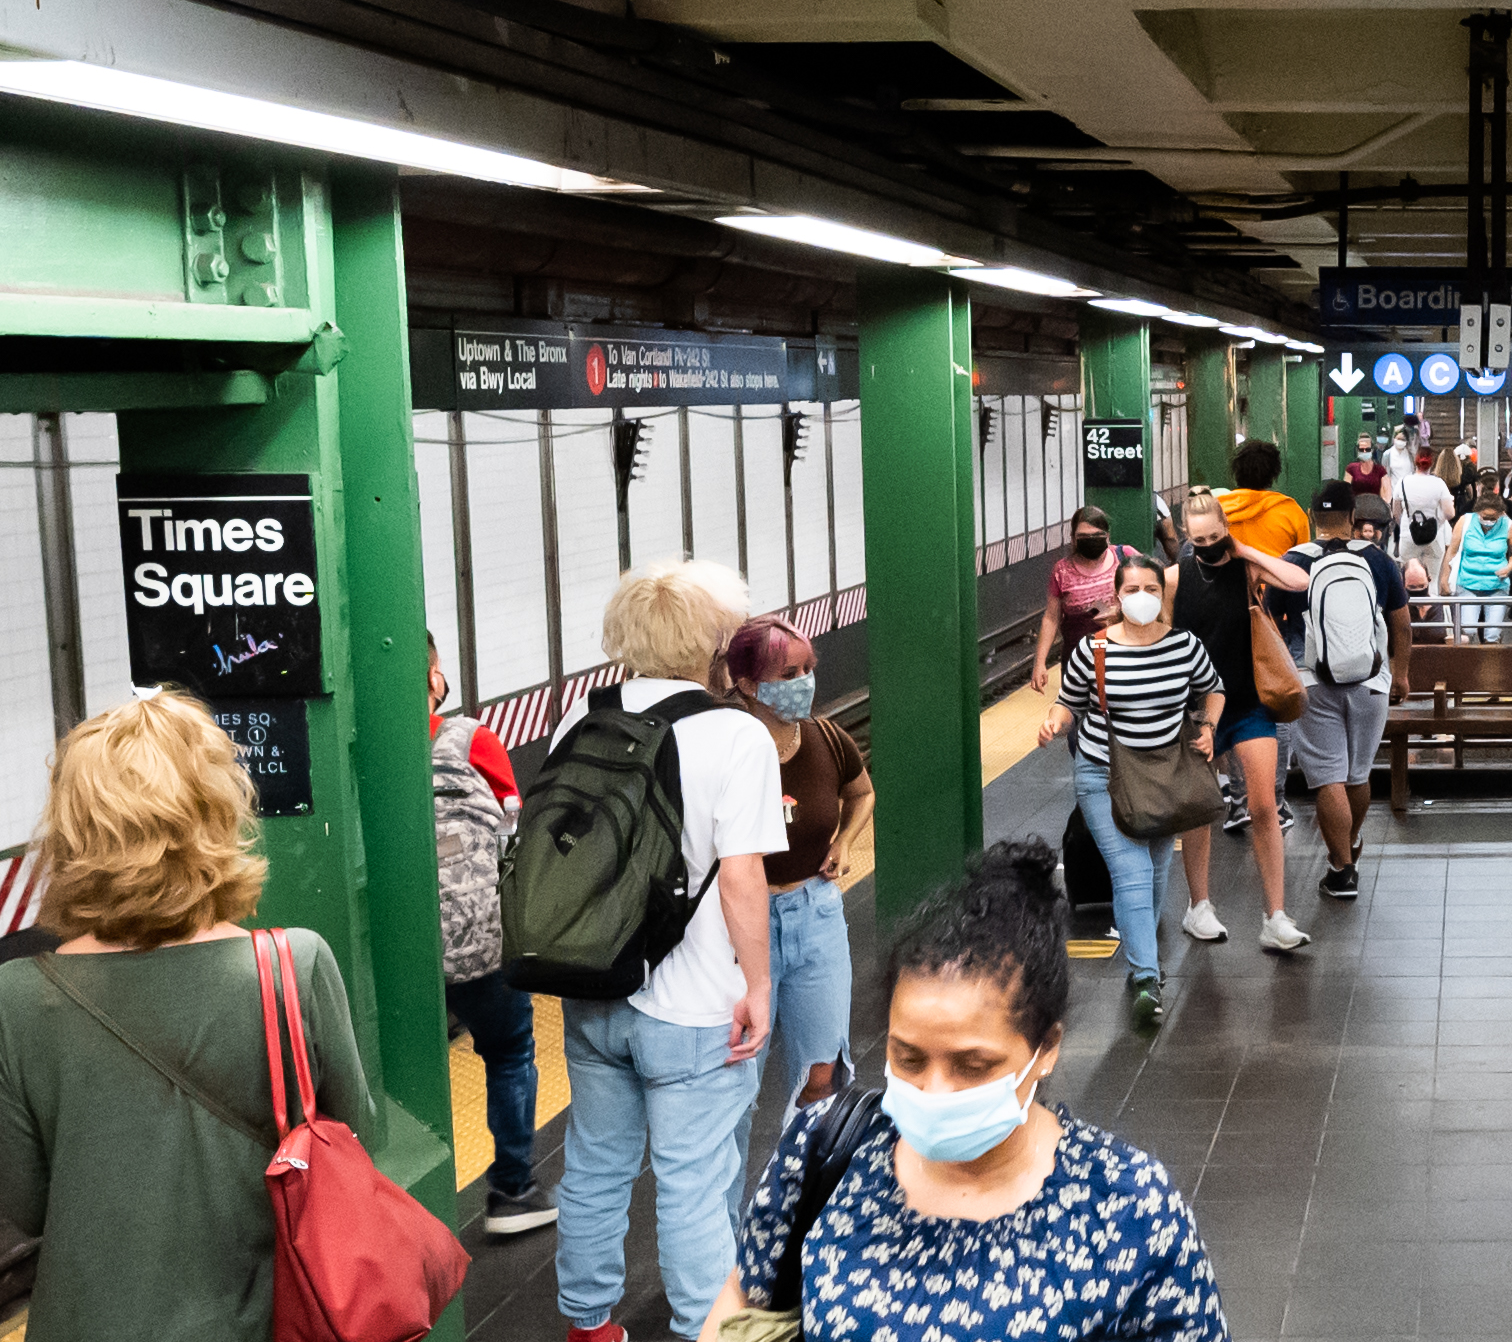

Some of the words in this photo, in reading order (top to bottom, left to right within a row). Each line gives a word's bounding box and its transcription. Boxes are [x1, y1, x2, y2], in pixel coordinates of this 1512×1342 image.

[1357, 284, 1489, 313] Boardi
[458, 337, 501, 365] Uptown
[504, 339, 512, 362] &
[516, 340, 536, 362] The
[538, 341, 568, 363] Bronx
[607, 344, 618, 365] To
[621, 345, 637, 365] Van
[459, 366, 477, 390] via
[479, 366, 505, 395] Bwy
[507, 367, 536, 390] Local
[606, 367, 626, 389] Late
[629, 368, 652, 394] nights
[1086, 428, 1111, 444] 42
[1087, 443, 1144, 460] Street
[128, 509, 285, 552] Times
[133, 562, 315, 615] Square
[258, 761, 288, 774] LCL
